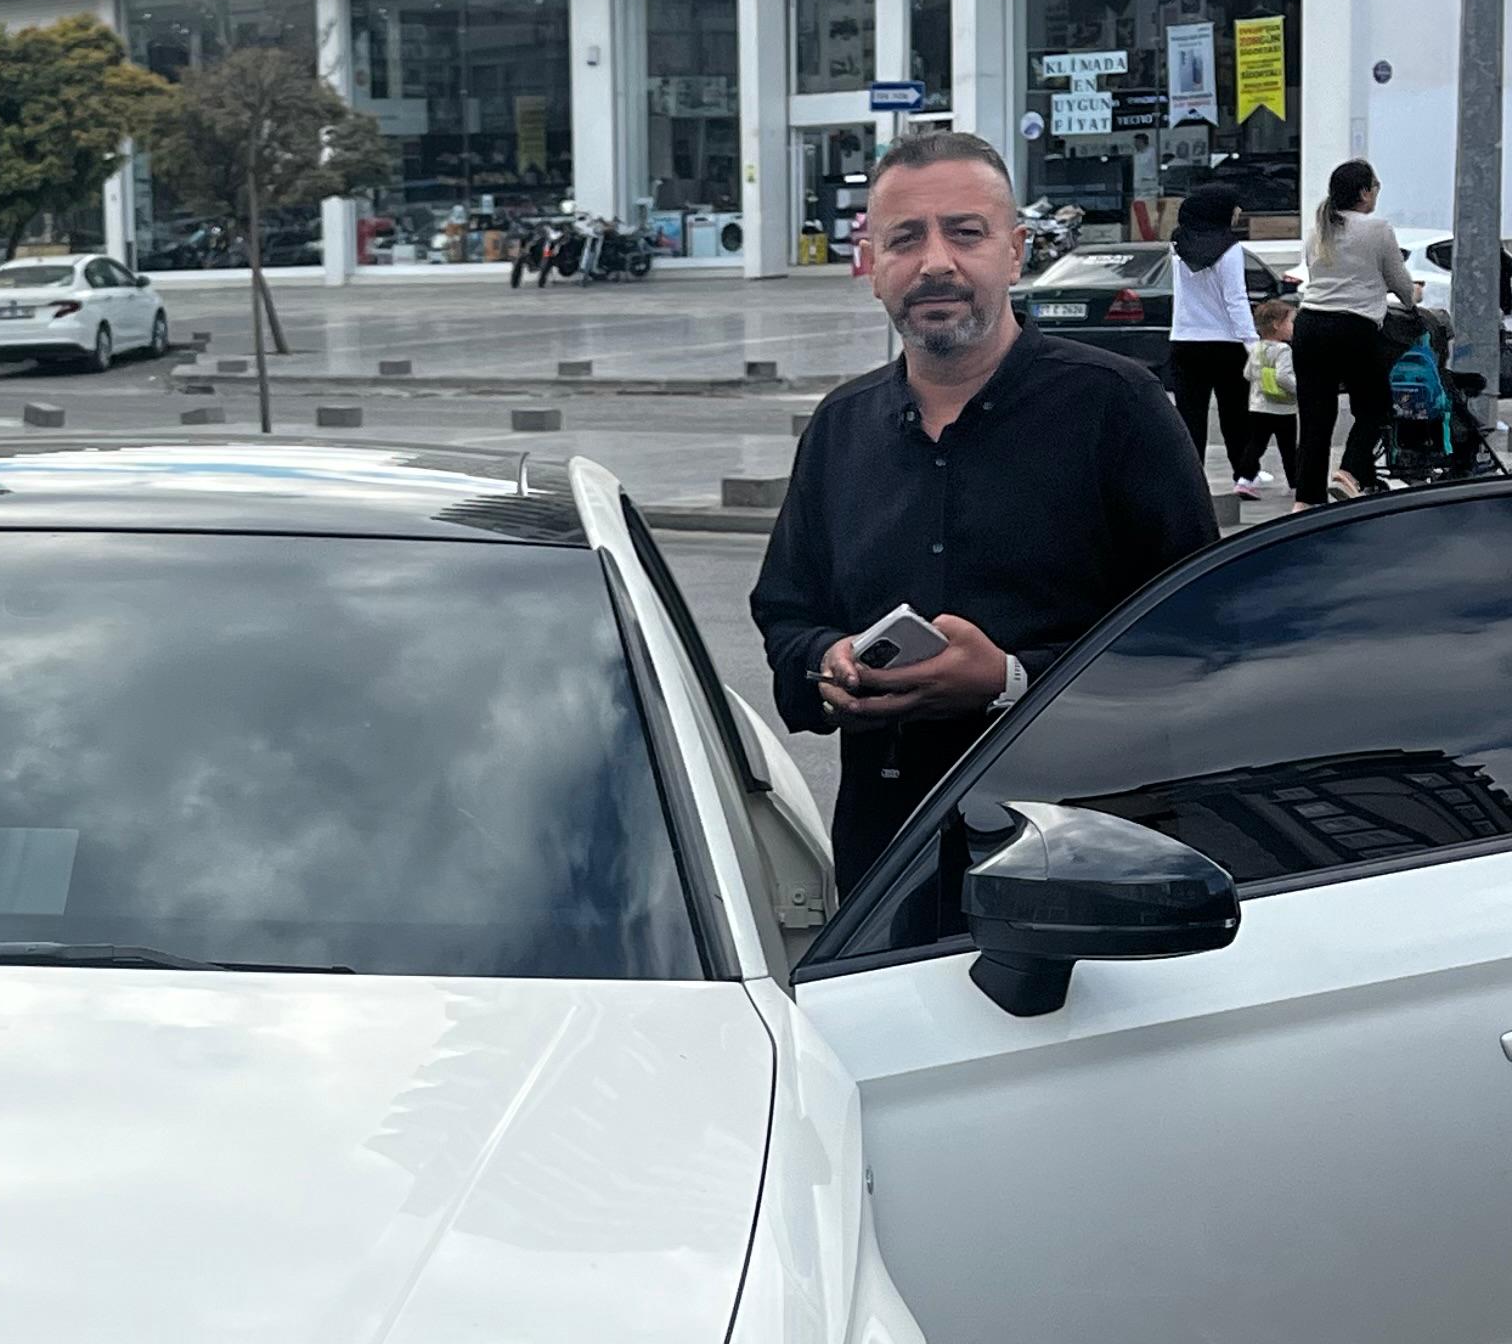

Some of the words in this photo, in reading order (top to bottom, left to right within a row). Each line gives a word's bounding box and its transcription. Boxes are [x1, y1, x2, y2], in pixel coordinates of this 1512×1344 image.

[1074, 79, 1097, 92] EN
[1054, 97, 1112, 113] UYGUN
[1054, 117, 1110, 132] FİYAT
